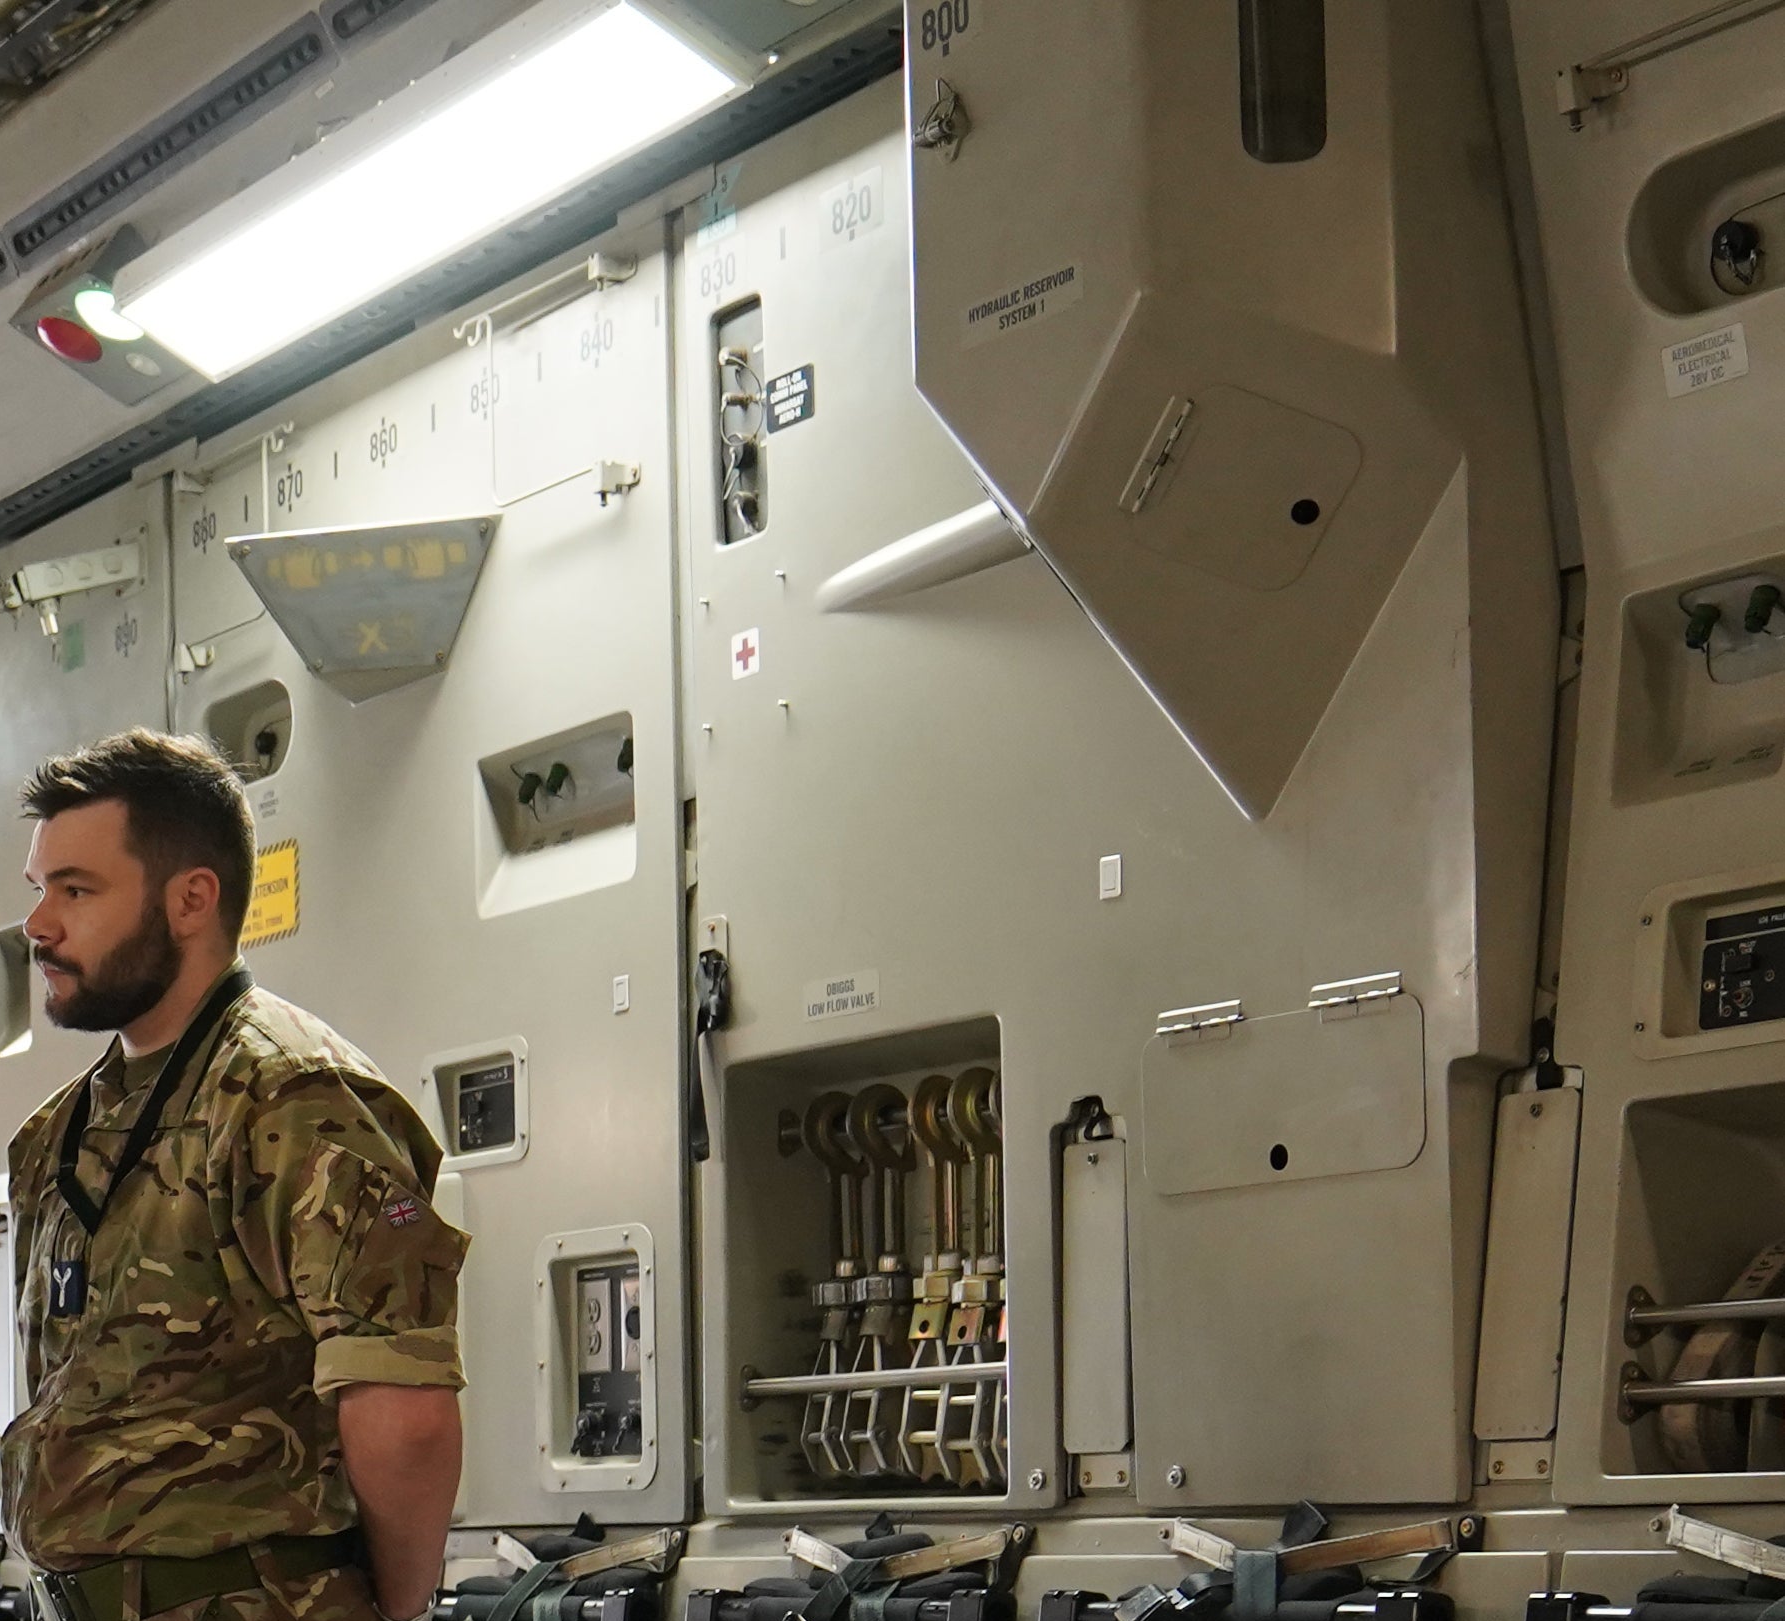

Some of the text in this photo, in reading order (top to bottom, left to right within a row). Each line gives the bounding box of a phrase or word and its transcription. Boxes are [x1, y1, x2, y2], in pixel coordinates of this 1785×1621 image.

[922, 0, 969, 51] 800
[832, 185, 872, 235] 820
[700, 252, 736, 298] 830
[969, 266, 1075, 323] HYDRAULIC RESERVOIR
[999, 299, 1045, 330] SYSTEM 1
[581, 319, 613, 362] 840
[1672, 332, 1736, 362] AEROMEDICAL
[1678, 349, 1731, 376] ELECTRICAL
[1691, 366, 1725, 387] 28V DC
[471, 373, 500, 414] 850
[370, 423, 398, 463] 860
[277, 469, 303, 507] 870
[192, 512, 216, 548] 880
[253, 877, 288, 899] XTENSION
[807, 991, 875, 1017] LOW FLOW VALVE
[826, 978, 855, 998] OBIGGS
